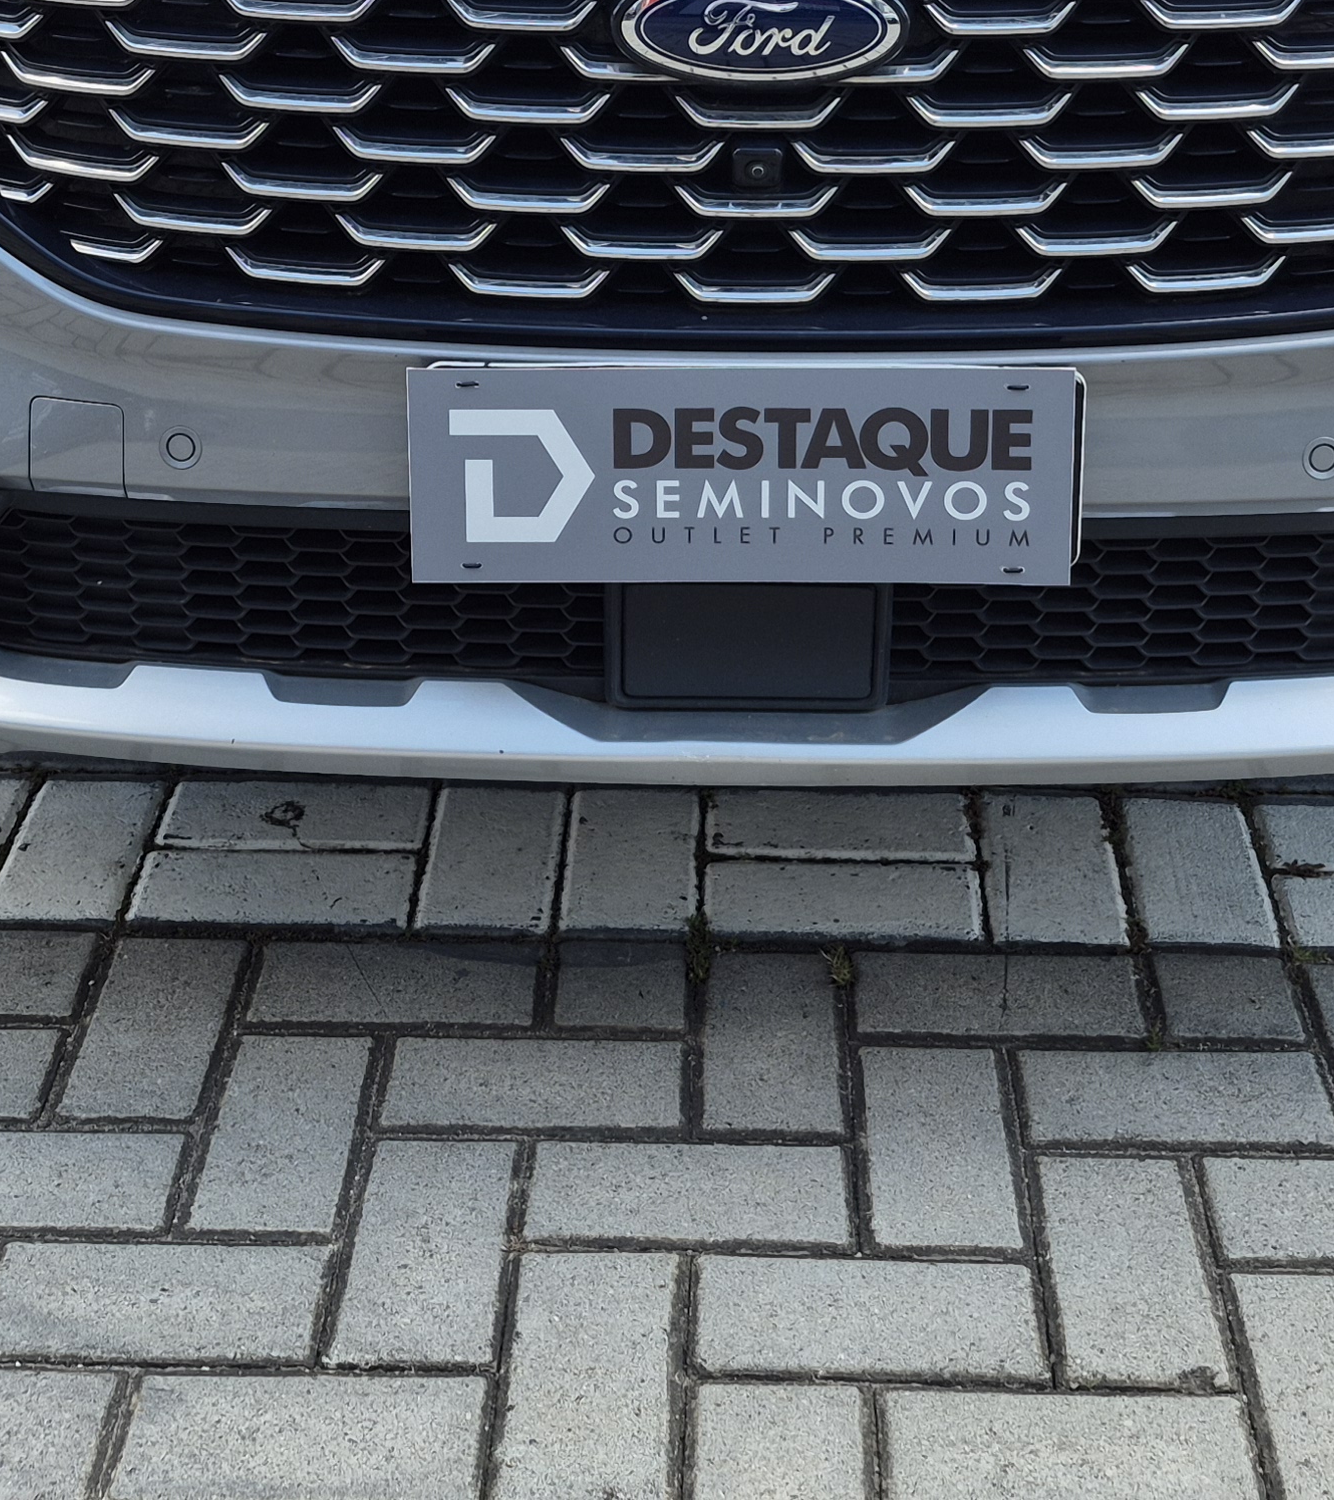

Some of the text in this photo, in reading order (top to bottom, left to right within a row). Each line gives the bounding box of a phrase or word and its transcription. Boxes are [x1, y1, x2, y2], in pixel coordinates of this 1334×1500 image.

[612, 406, 1033, 477] DESTAQUE
[613, 479, 1032, 522] SEMINOVOS
[613, 526, 1031, 548] OUTLET PREMIUM
